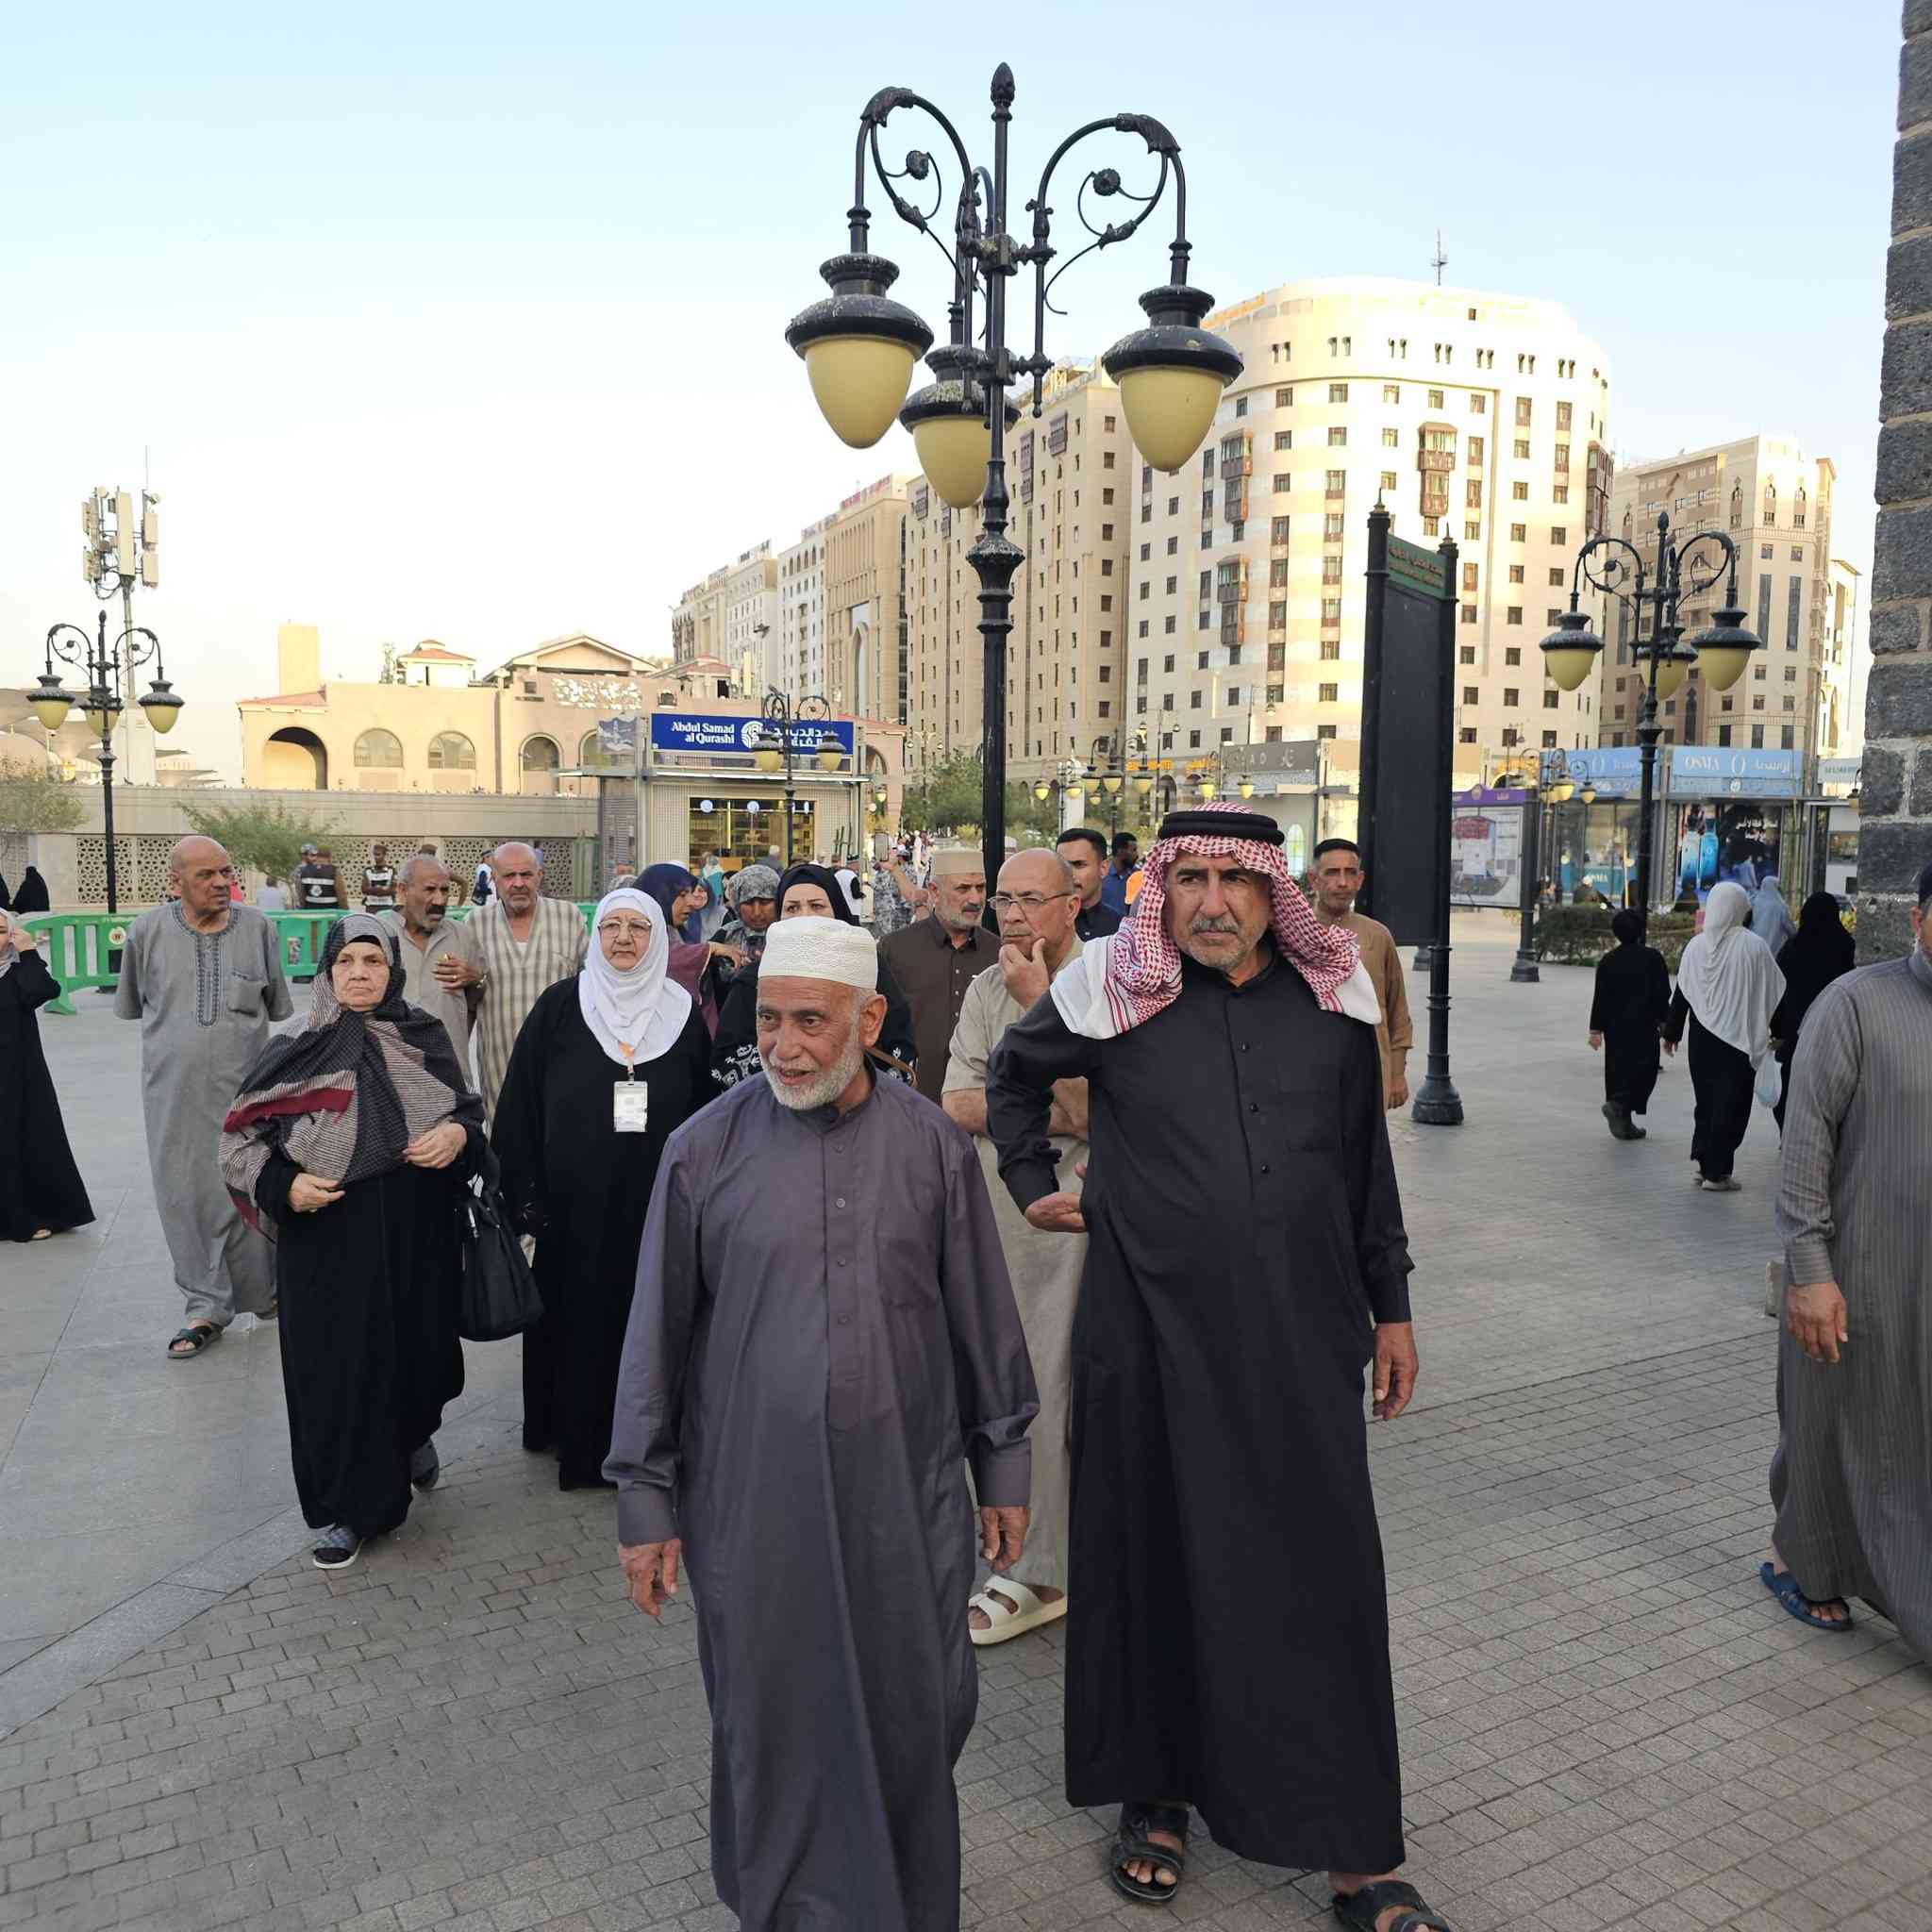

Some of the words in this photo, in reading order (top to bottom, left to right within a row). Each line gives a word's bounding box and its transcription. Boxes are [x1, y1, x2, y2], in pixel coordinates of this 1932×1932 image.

[671, 722, 700, 732] Abdul
[702, 723, 735, 734] Samad
[685, 732, 695, 742] al
[695, 733, 735, 744] Qurashi
[1684, 754, 1720, 771] OSMA
